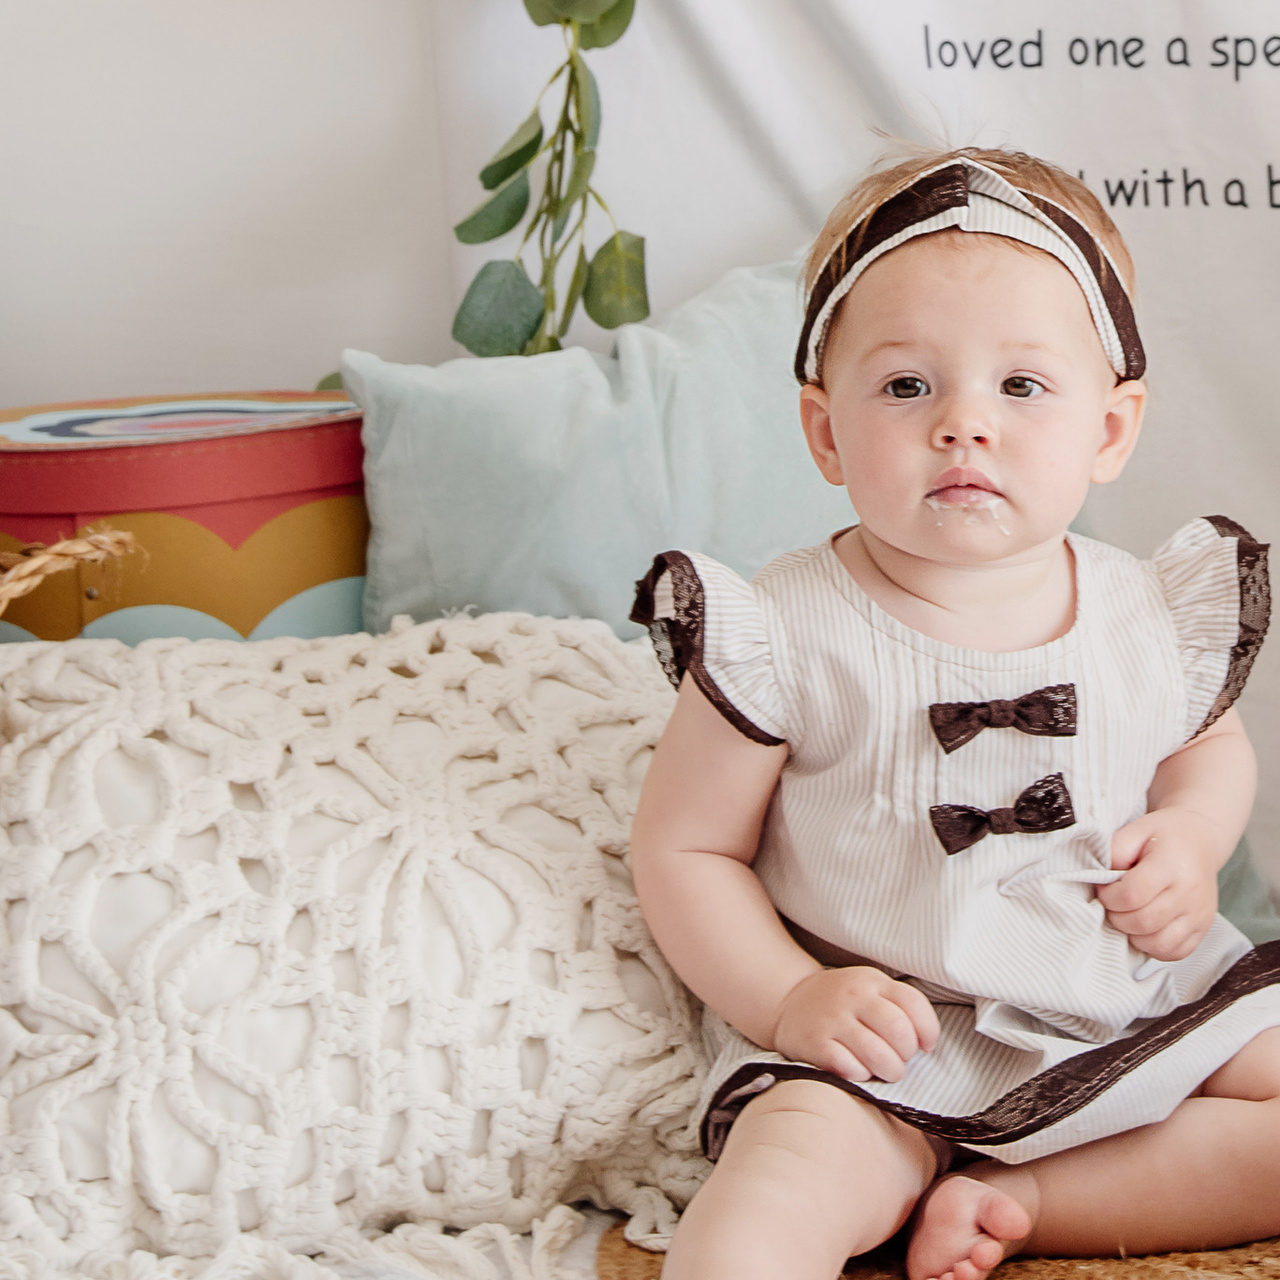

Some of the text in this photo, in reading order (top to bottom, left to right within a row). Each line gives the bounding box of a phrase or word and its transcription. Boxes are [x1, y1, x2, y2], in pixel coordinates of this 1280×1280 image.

[923, 24, 1044, 70] loved
[1067, 36, 1146, 69] one
[1165, 36, 1191, 68] a
[1104, 167, 1210, 208] with
[1222, 178, 1250, 210] a
